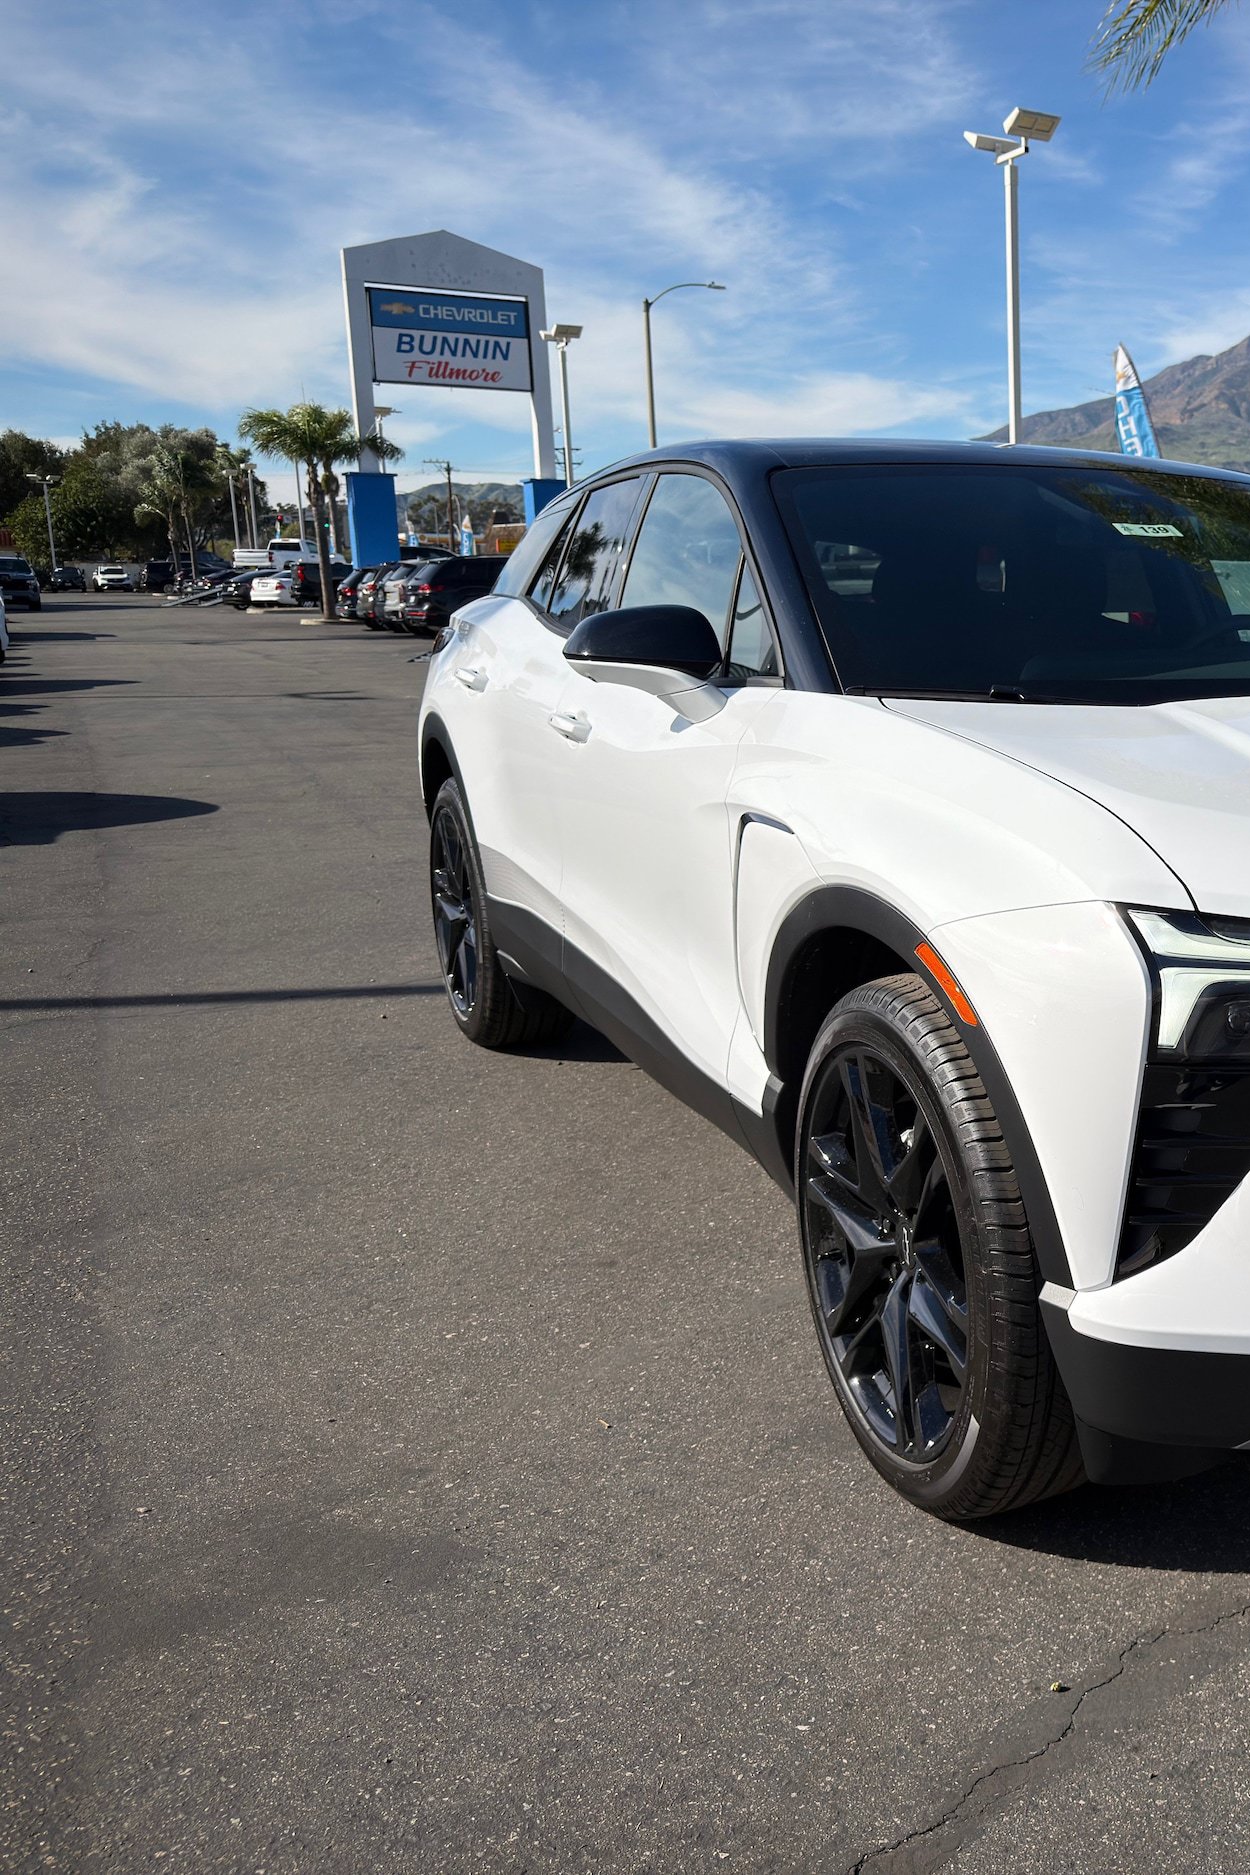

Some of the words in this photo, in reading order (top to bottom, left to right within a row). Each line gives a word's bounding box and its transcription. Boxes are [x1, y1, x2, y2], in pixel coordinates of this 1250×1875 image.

[419, 304, 518, 326] CHEVROLET
[396, 333, 511, 361] BUNNIN
[403, 360, 503, 383] Fillmore
[1139, 526, 1170, 534] 139
